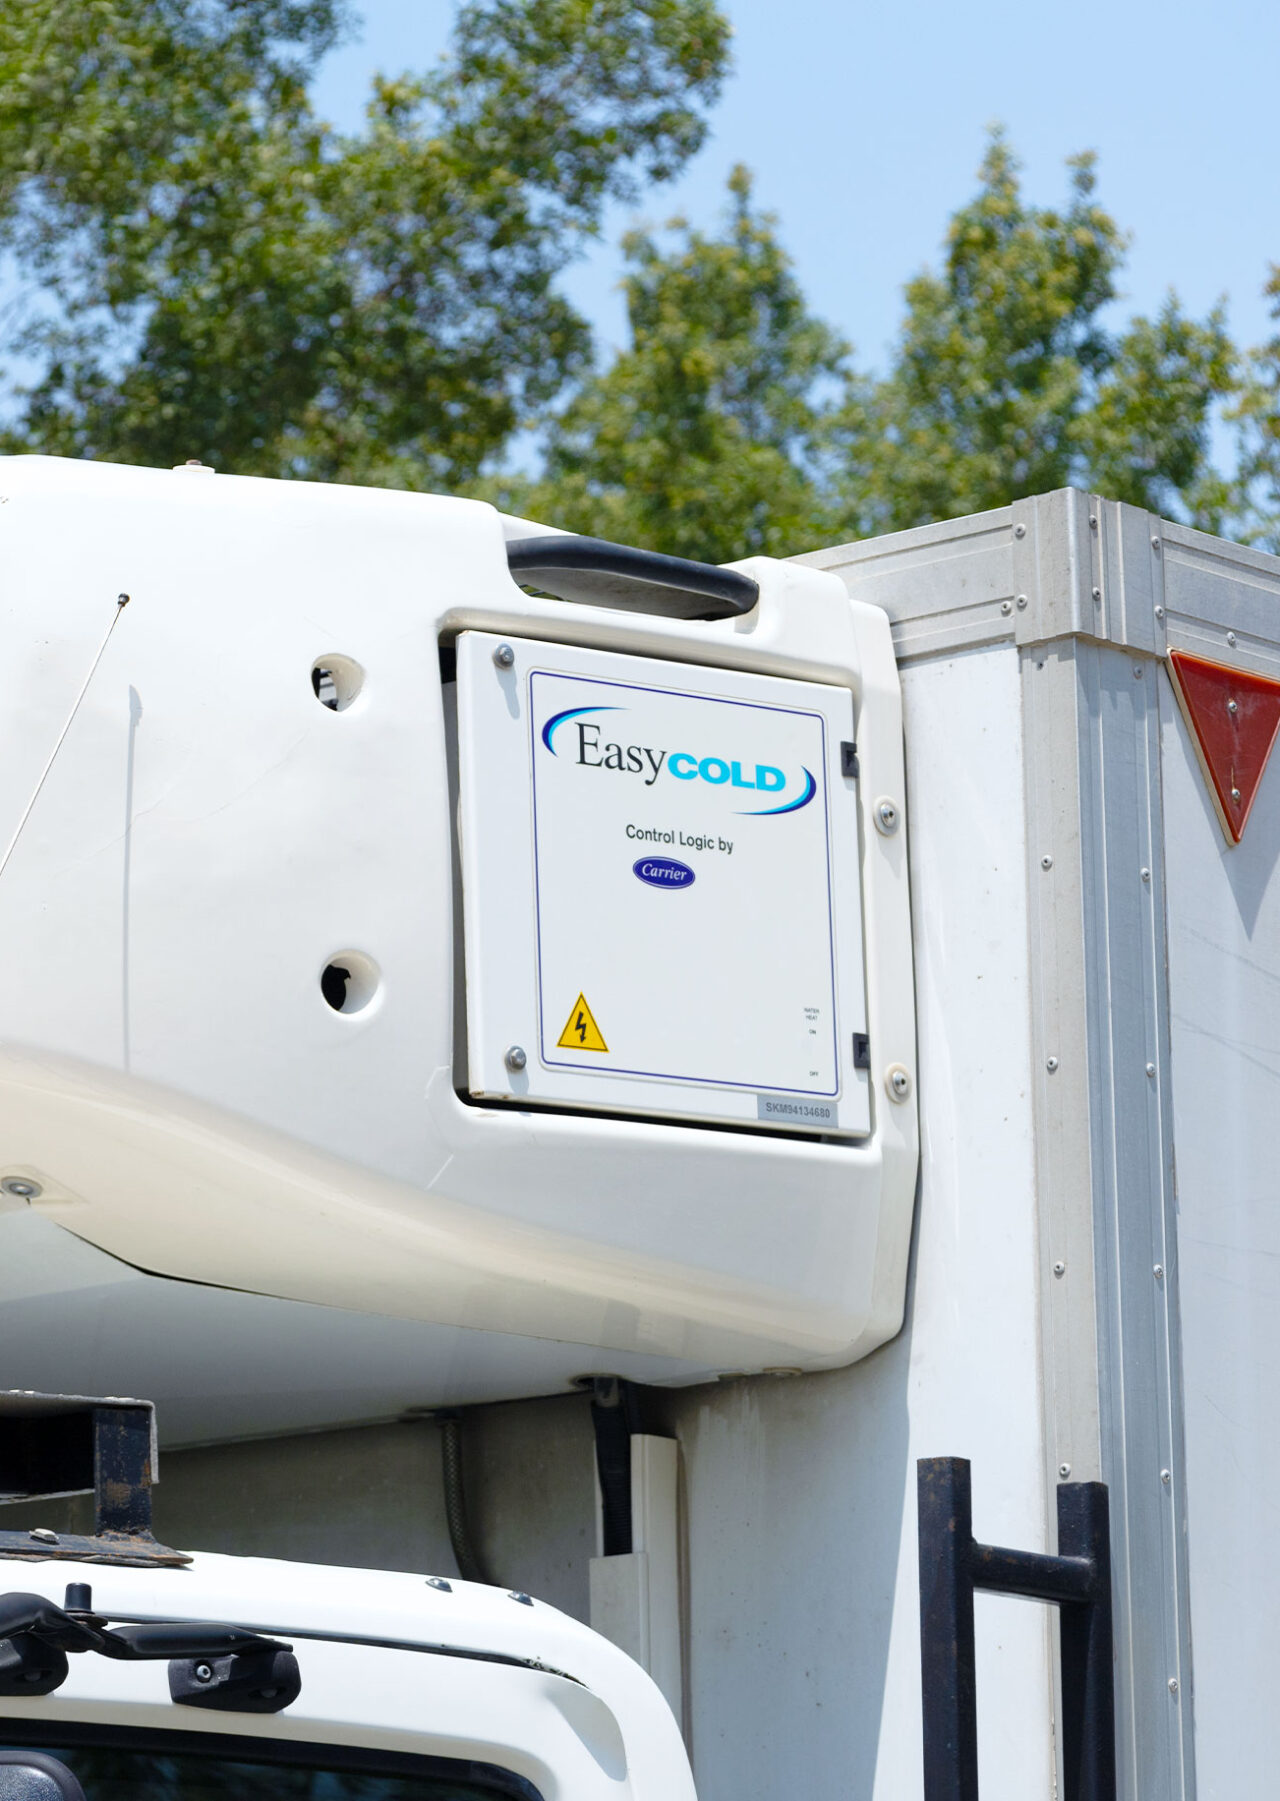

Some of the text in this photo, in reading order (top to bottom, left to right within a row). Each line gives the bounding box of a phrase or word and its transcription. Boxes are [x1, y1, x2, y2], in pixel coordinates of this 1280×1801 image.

[625, 824, 733, 855] Control Logic by
[642, 863, 687, 880] Carrier
